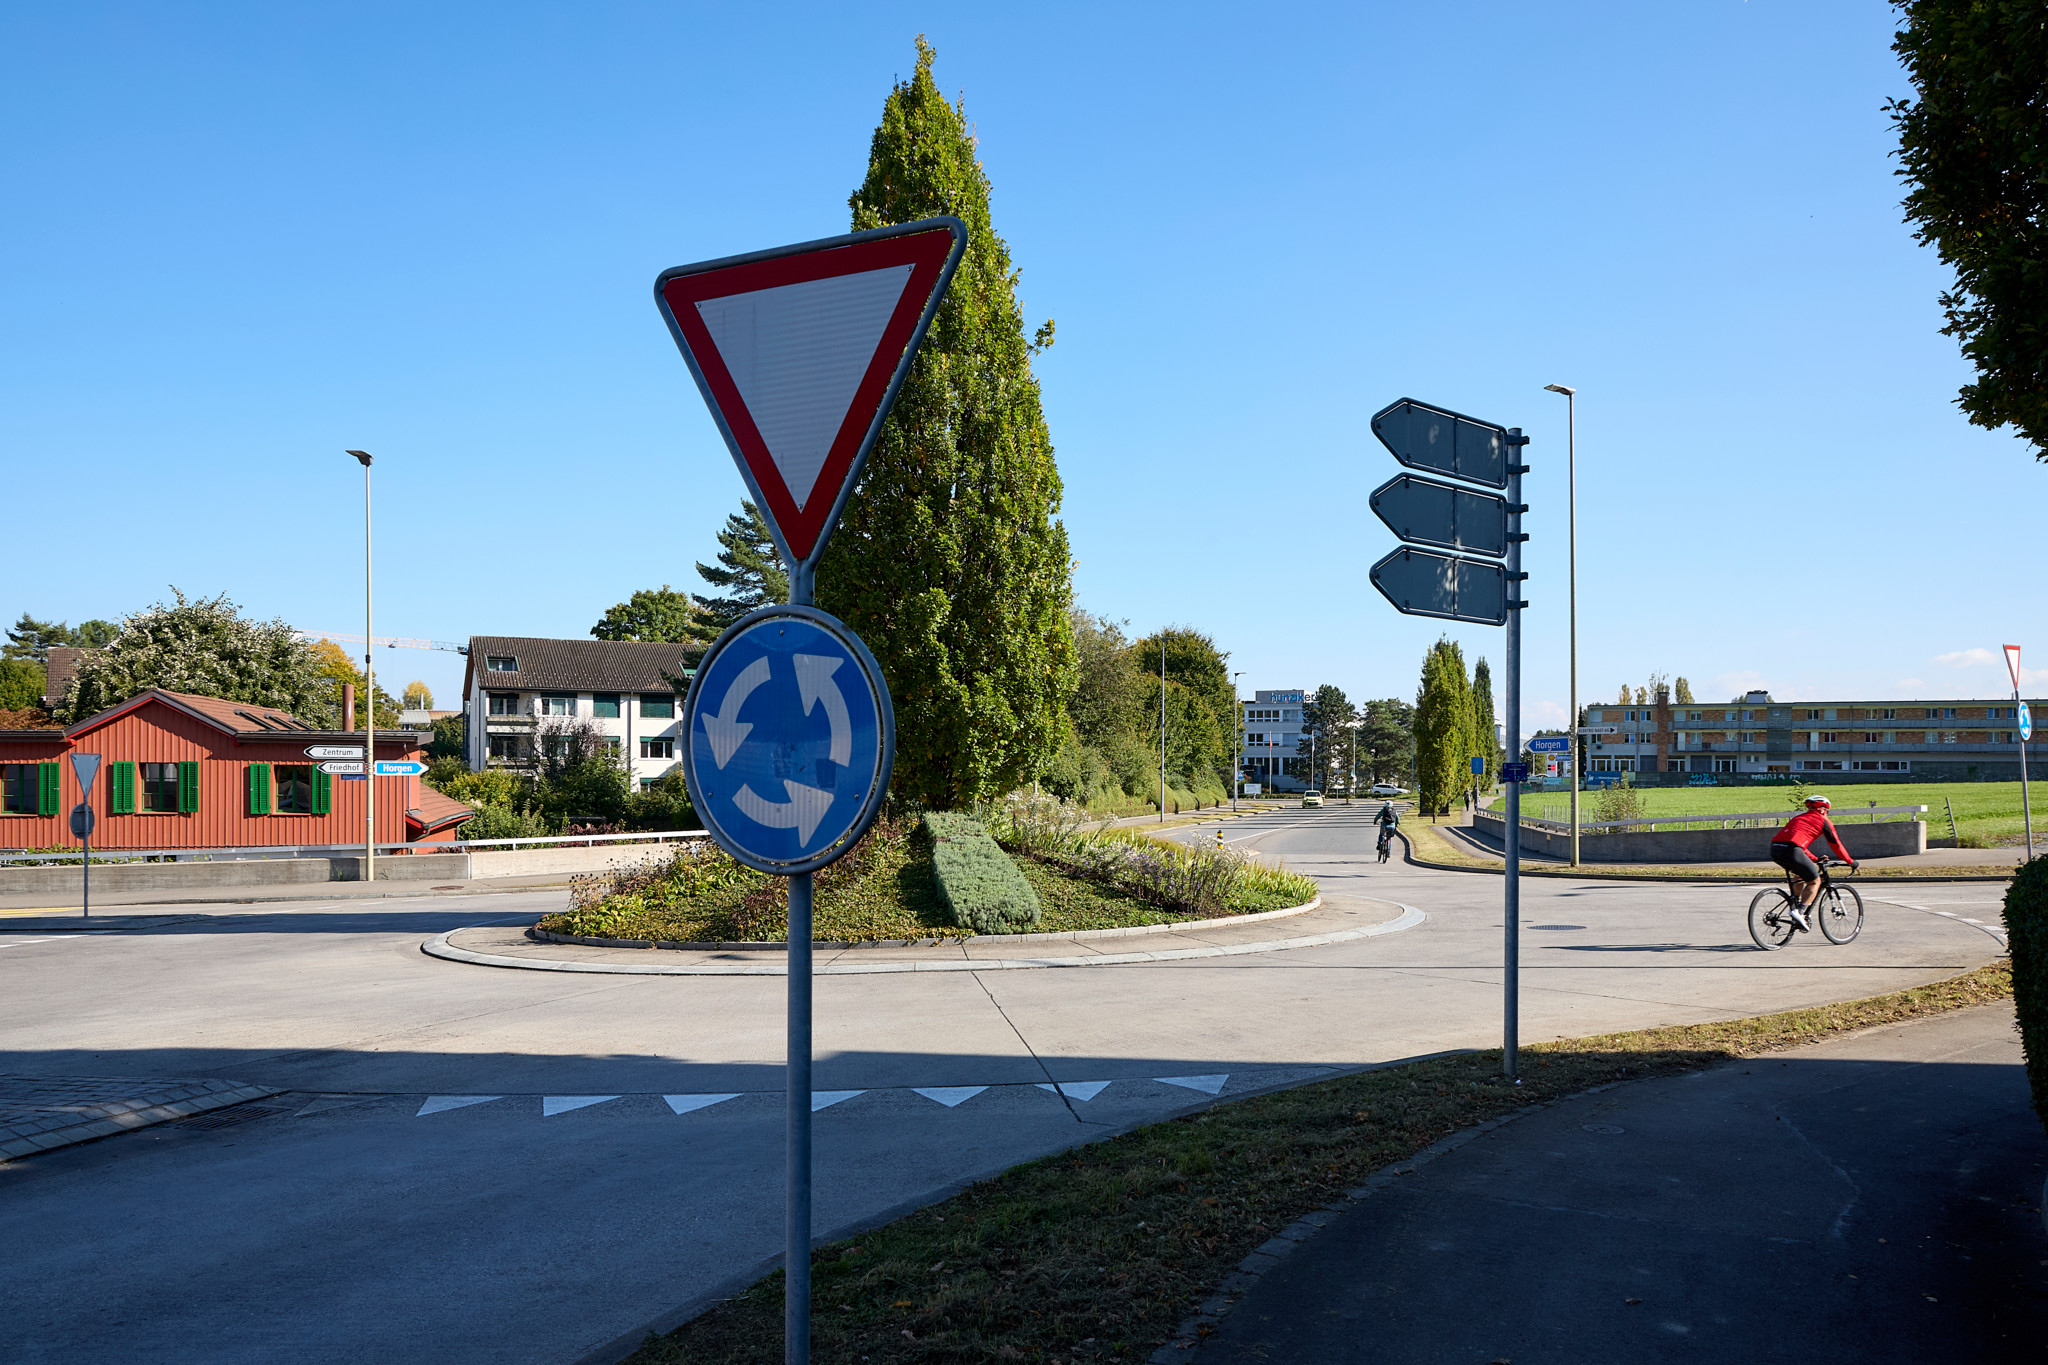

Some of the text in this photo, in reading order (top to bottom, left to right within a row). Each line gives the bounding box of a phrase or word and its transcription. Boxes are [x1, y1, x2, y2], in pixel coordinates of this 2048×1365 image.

[1270, 692, 1315, 702] hunziker
[1536, 740, 1560, 751] Horgen
[382, 764, 412, 773] Horgen
